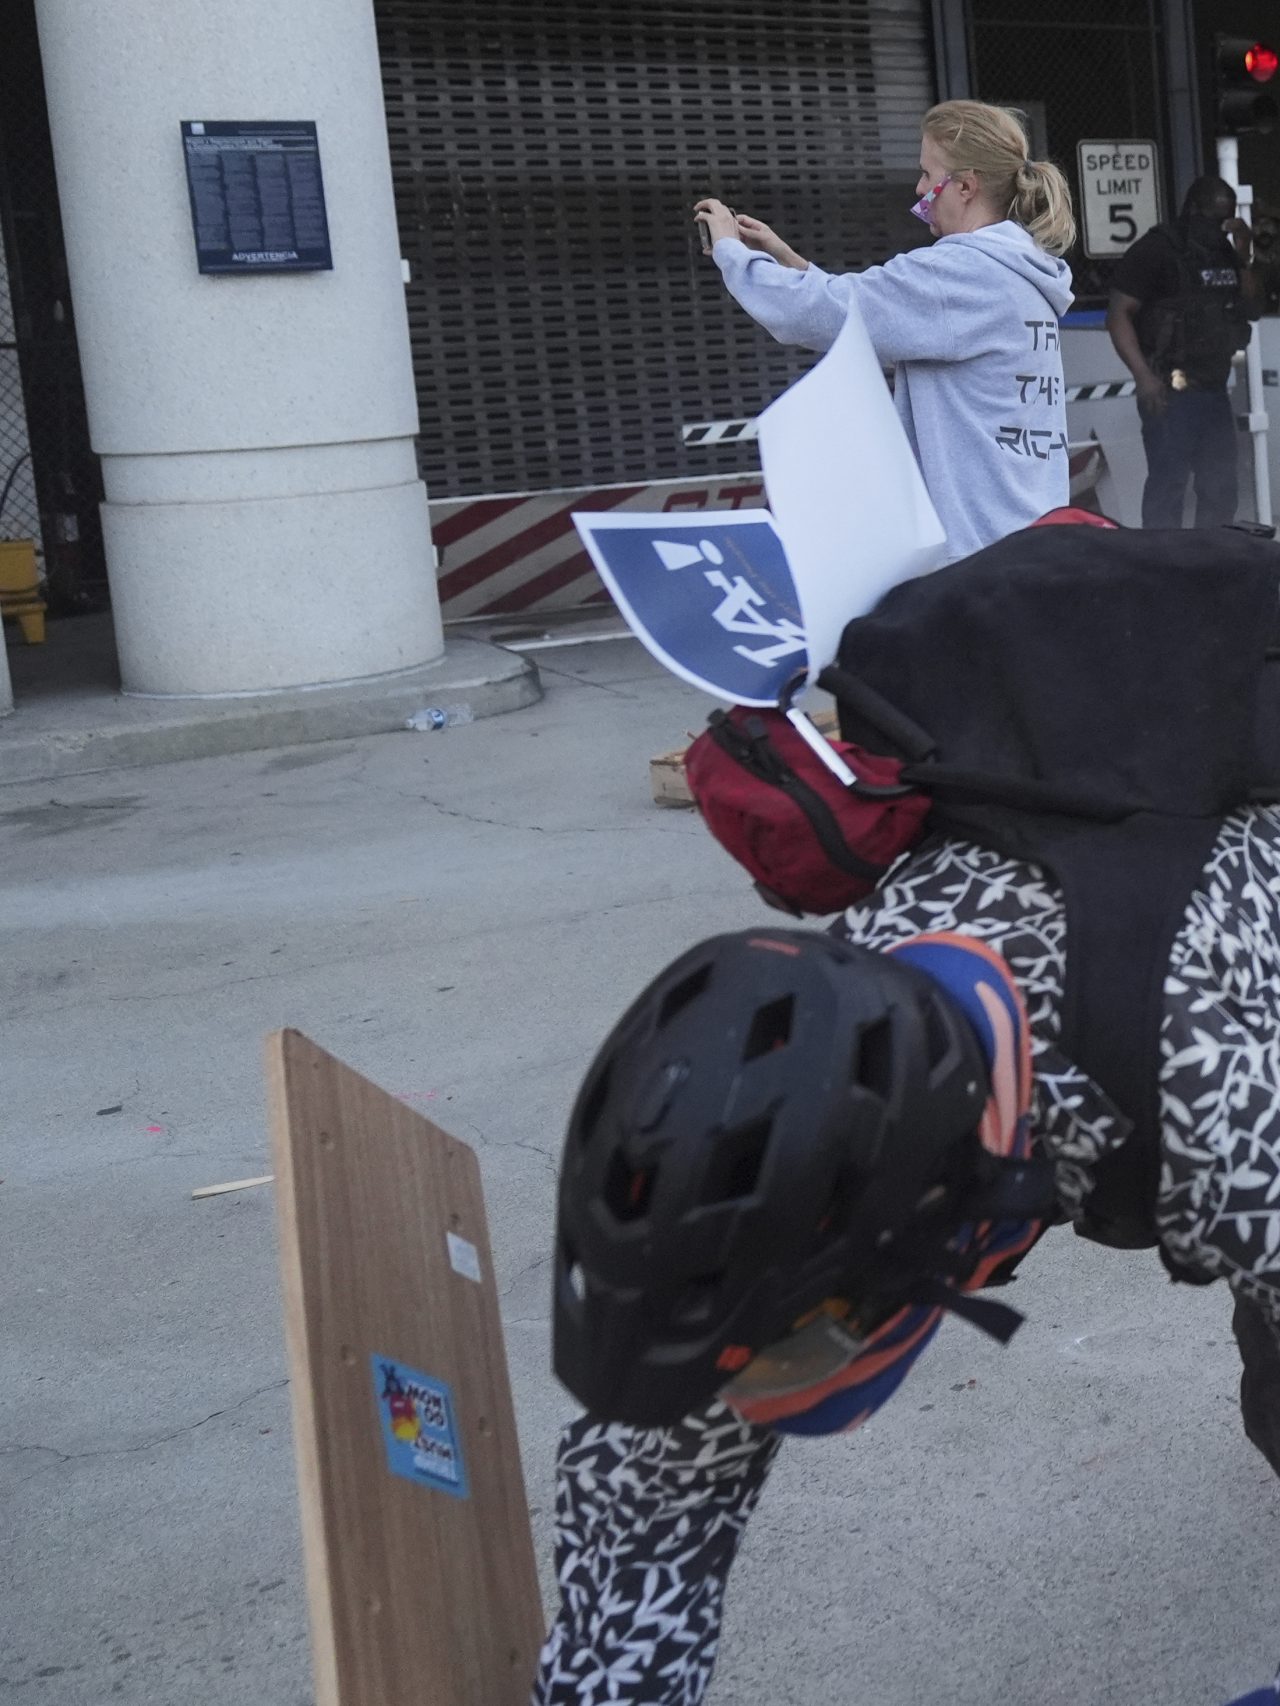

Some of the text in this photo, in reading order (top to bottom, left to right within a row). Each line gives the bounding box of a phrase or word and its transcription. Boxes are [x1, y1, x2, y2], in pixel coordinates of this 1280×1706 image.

[1086, 153, 1150, 171] SPEED
[1096, 178, 1142, 195] LIMIT
[1108, 203, 1137, 243] 5
[232, 250, 299, 262] ADVERTENCIA
